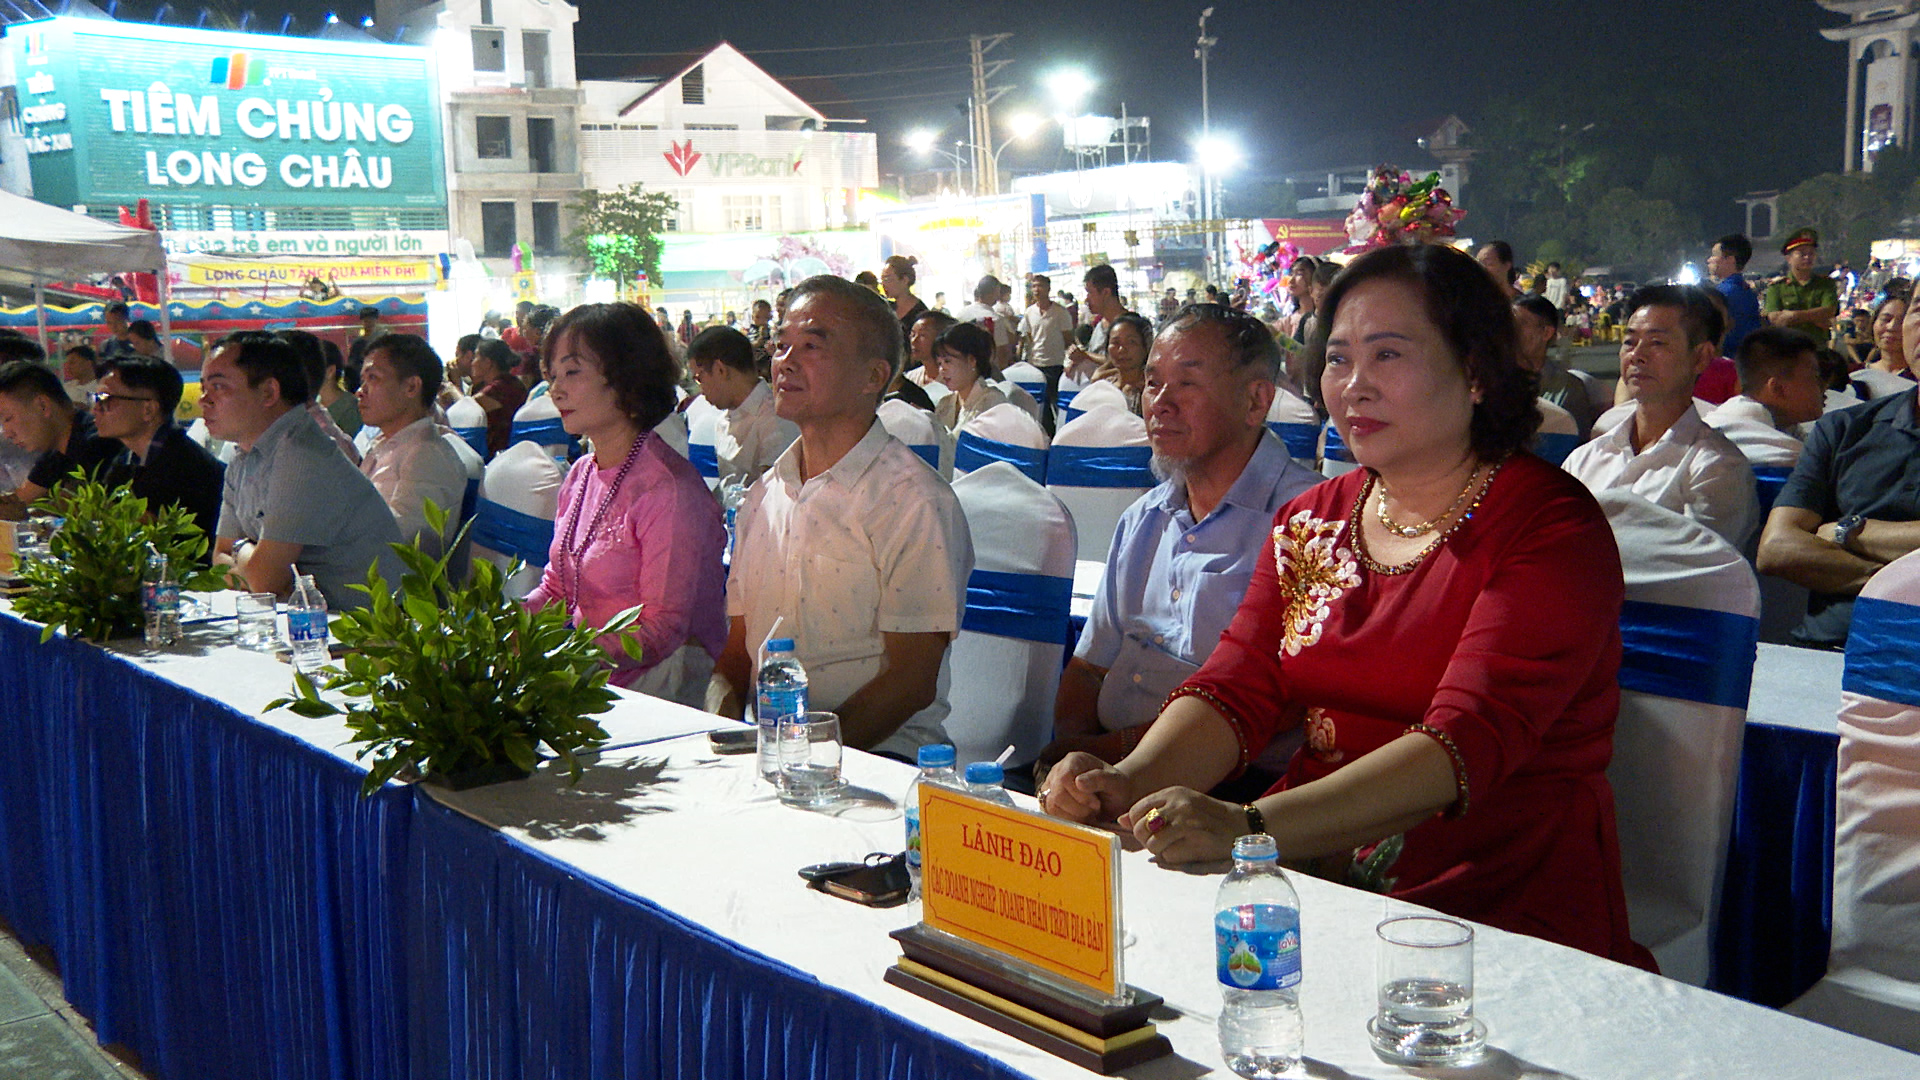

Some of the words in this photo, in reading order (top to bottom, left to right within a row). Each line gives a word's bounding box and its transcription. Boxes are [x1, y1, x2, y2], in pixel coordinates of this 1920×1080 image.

[100, 81, 221, 136] TIÊM
[237, 87, 414, 143] CHỦNG
[146, 150, 267, 186] LONG
[280, 148, 392, 188] CHÂU
[705, 150, 803, 177] VPBank
[267, 239, 298, 252] em
[304, 234, 329, 252] và
[335, 233, 388, 256] người
[395, 233, 422, 251] lớn
[205, 269, 244, 281] LONG
[249, 266, 287, 280] CHÂU
[1019, 841, 1061, 879] ĐẠO
[930, 857, 943, 895] CÁC
[945, 868, 969, 904] DOANH
[999, 888, 1025, 925] DOANH
[1025, 892, 1048, 932] NHÂN
[1049, 899, 1069, 939] TRÊN
[1071, 912, 1086, 953] ĐỊA
[1087, 911, 1103, 952] BÀN
